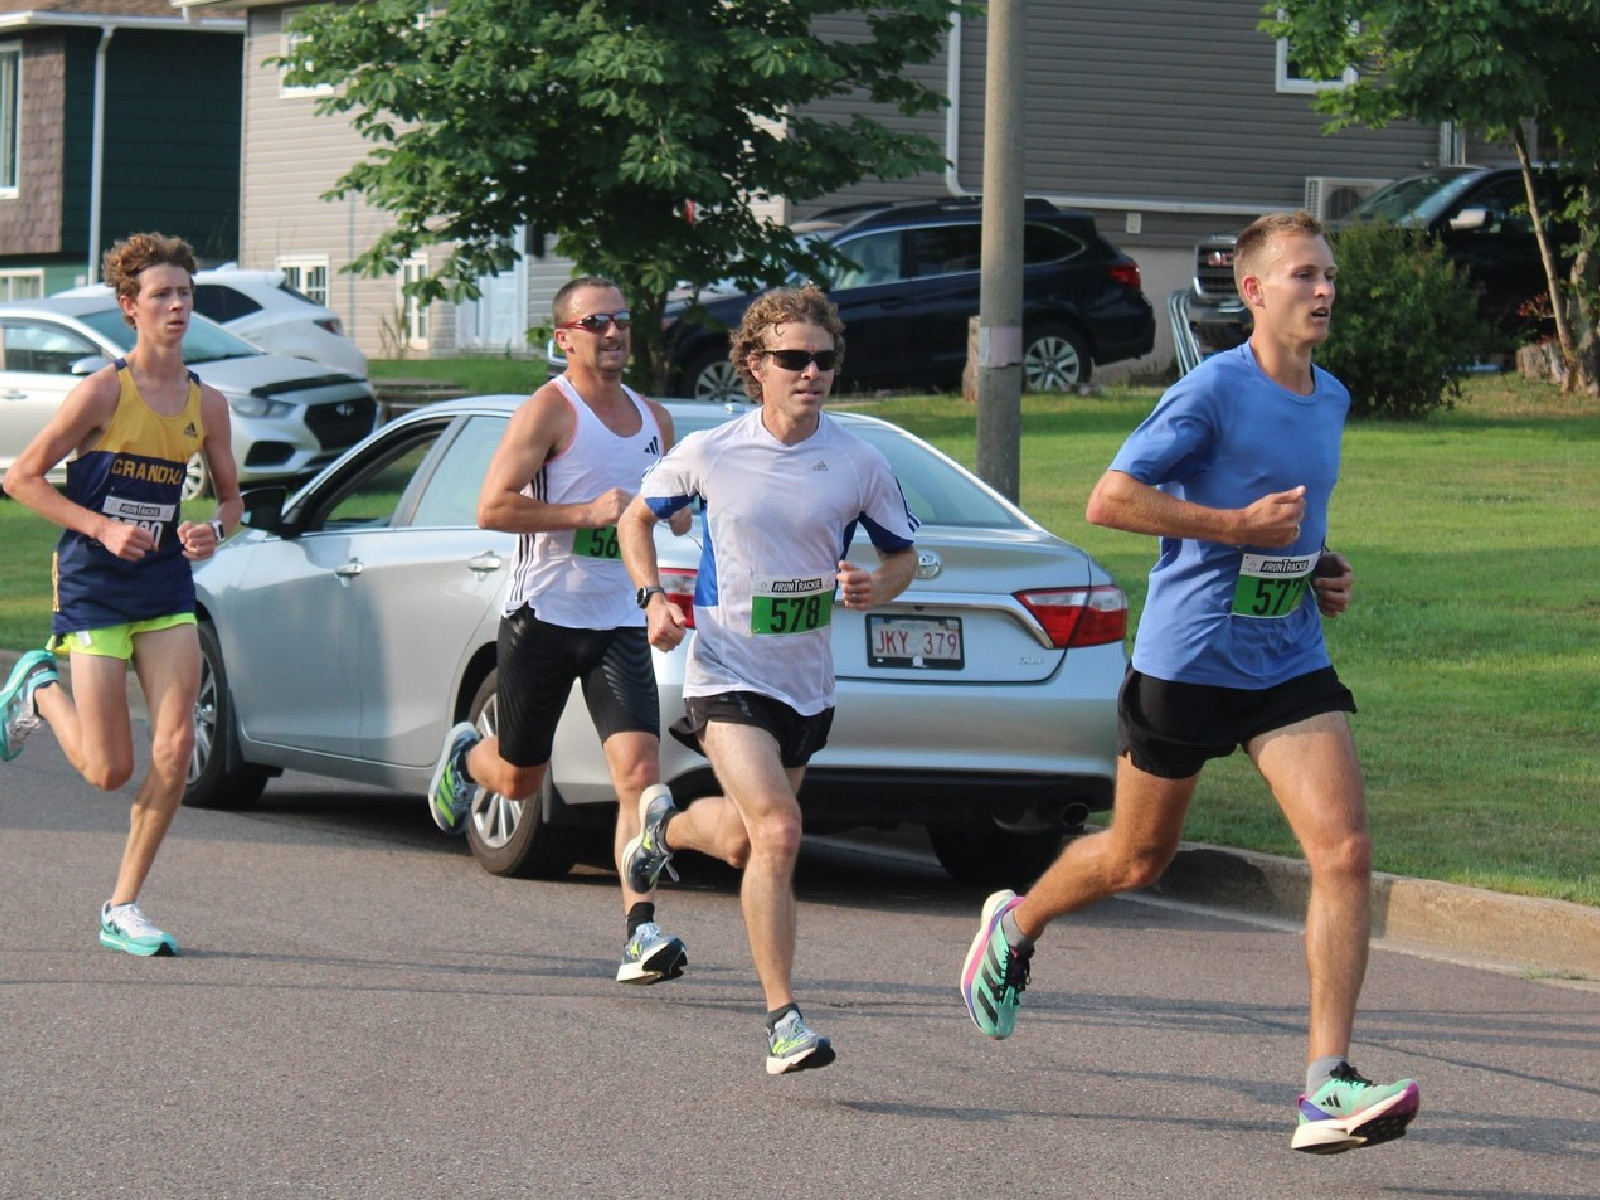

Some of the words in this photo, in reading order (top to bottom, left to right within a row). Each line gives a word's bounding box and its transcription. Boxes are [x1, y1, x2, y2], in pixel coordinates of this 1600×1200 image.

[590, 528, 618, 558] 56
[1253, 578, 1304, 614] 577
[770, 596, 820, 633] 578
[876, 630, 908, 655] JKY
[923, 631, 957, 656] 379
